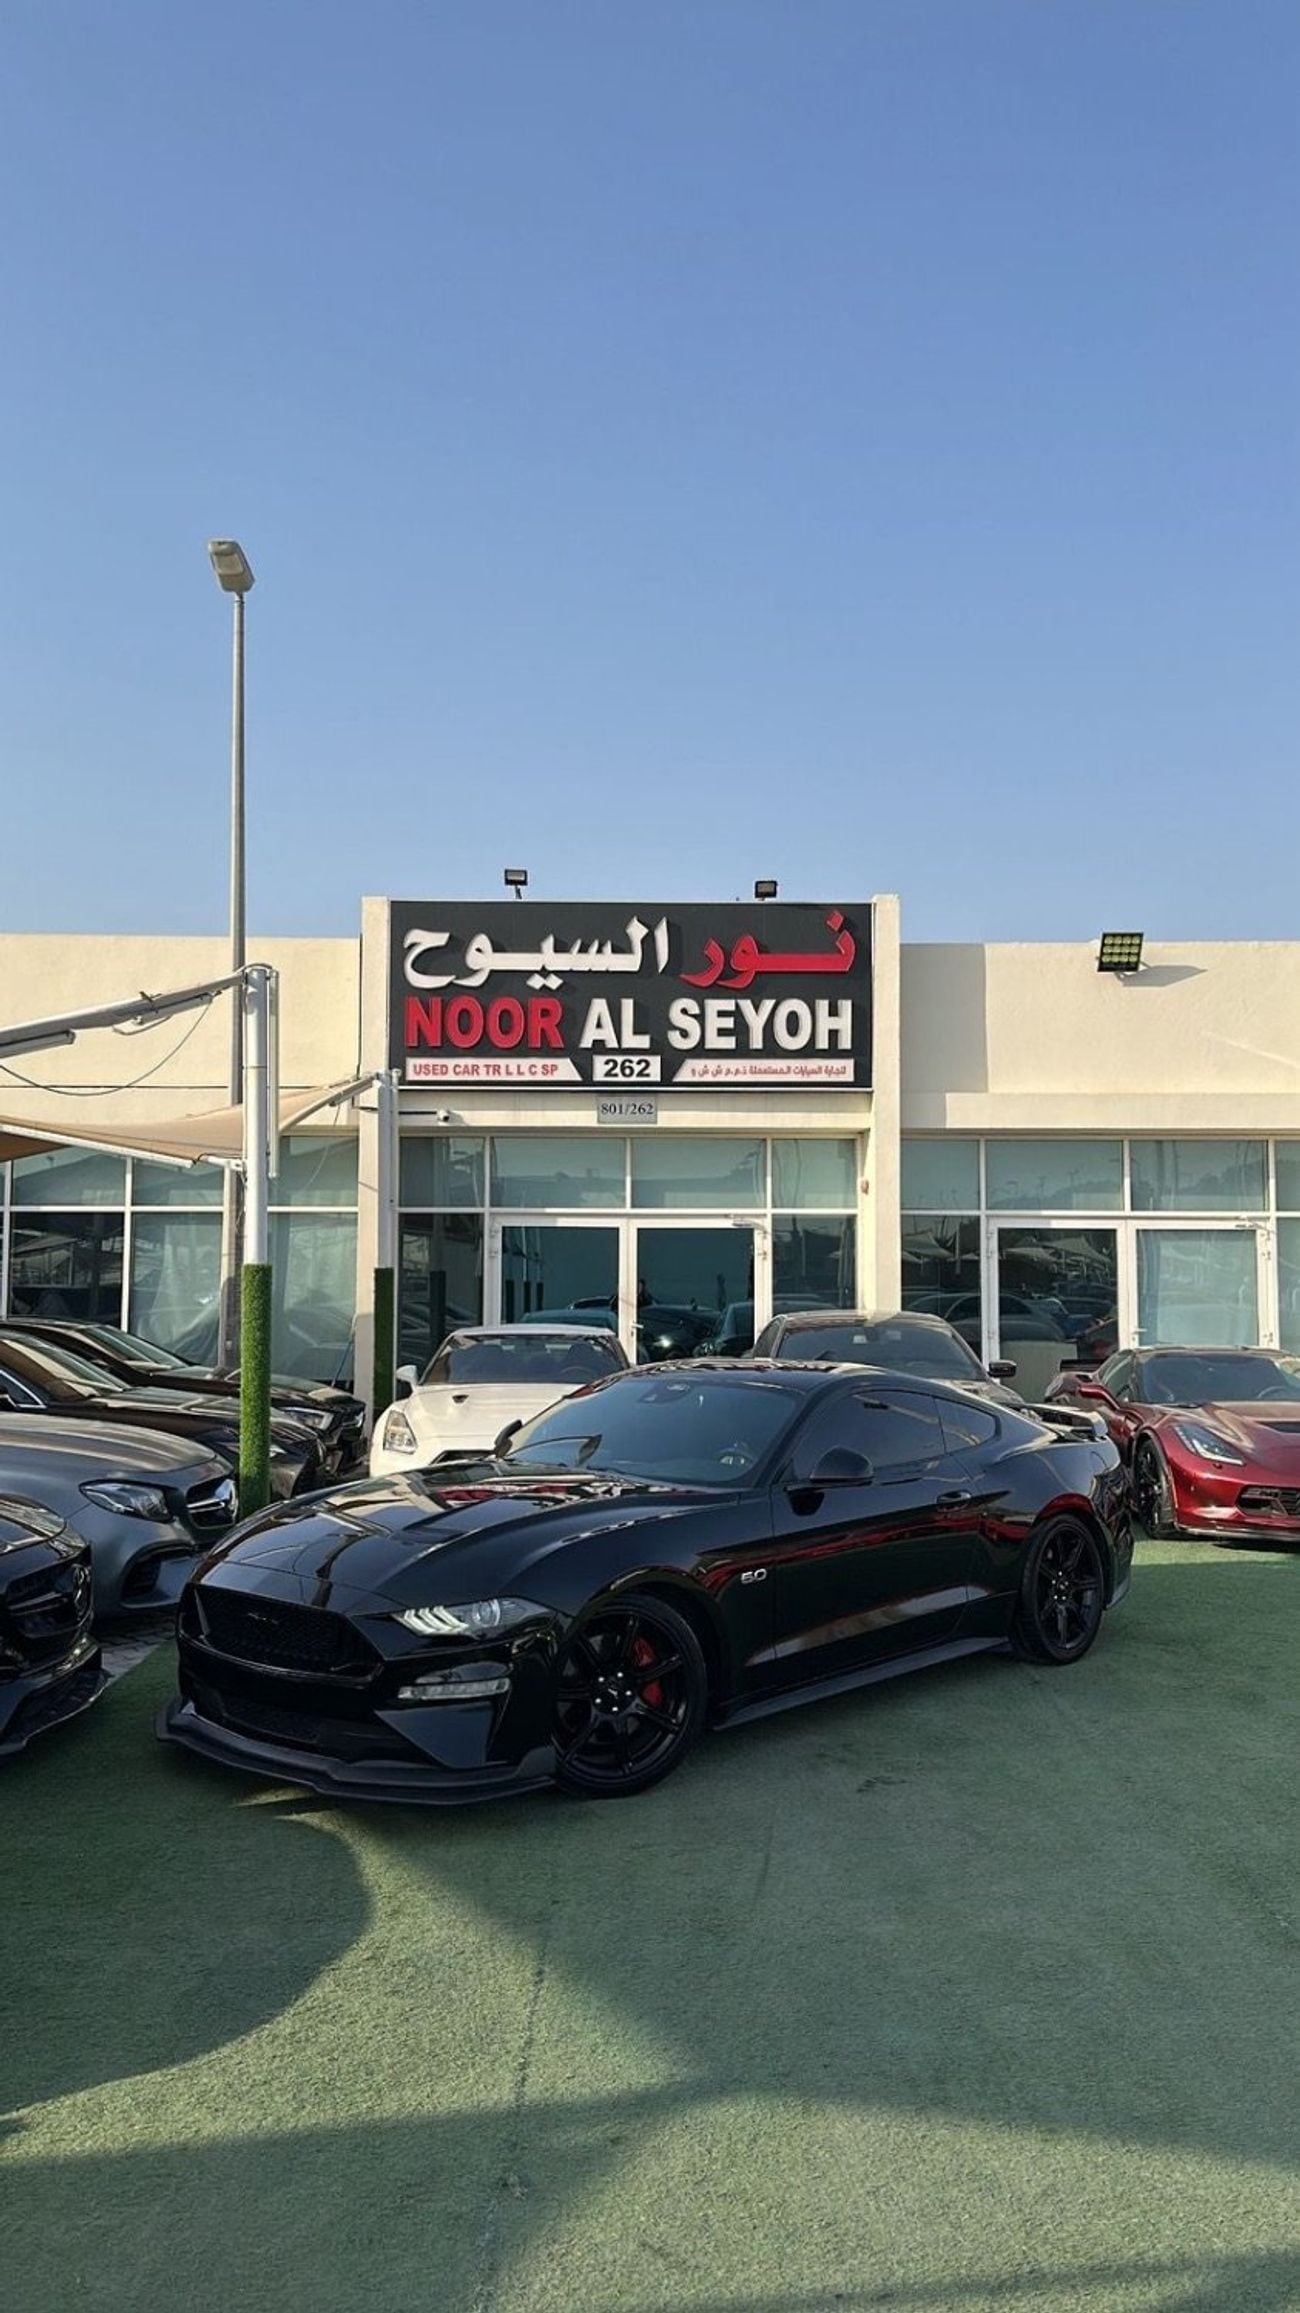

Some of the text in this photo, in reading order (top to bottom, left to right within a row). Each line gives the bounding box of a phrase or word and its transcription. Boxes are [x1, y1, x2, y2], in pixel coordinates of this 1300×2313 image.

[403, 909, 856, 990] نور السيوح
[404, 995, 853, 1051] NOOR AL SEYOH
[413, 1063, 449, 1077] USED
[453, 1063, 480, 1077] CAR
[483, 1063, 501, 1077] TR
[540, 1063, 558, 1077] SP
[603, 1058, 651, 1078] 262
[793, 1065, 822, 1079] السيارات
[601, 1103, 654, 1115] 801/262
[741, 1568, 767, 1584] 5.0
